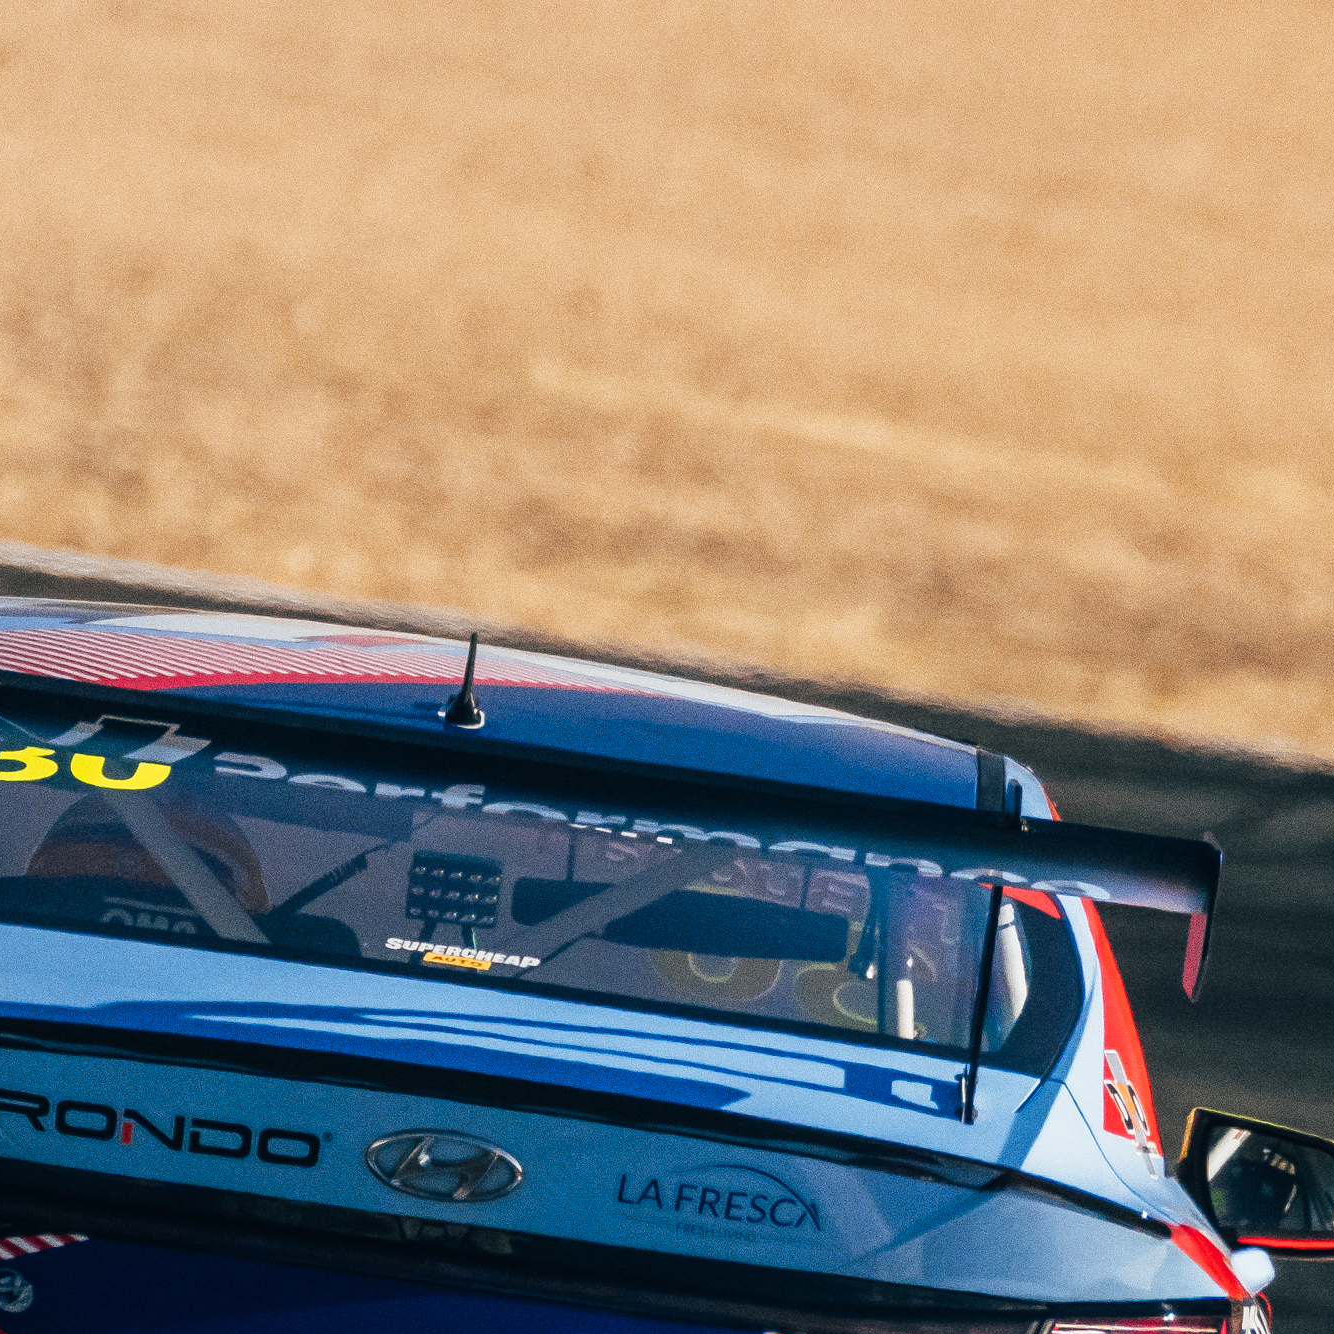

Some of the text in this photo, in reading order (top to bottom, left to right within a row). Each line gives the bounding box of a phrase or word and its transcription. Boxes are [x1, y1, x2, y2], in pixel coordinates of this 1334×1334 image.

[384, 937, 541, 968] SUPERCHEAP
[431, 955, 483, 968] AUTO
[617, 1174, 821, 1232] LA FRESCA
